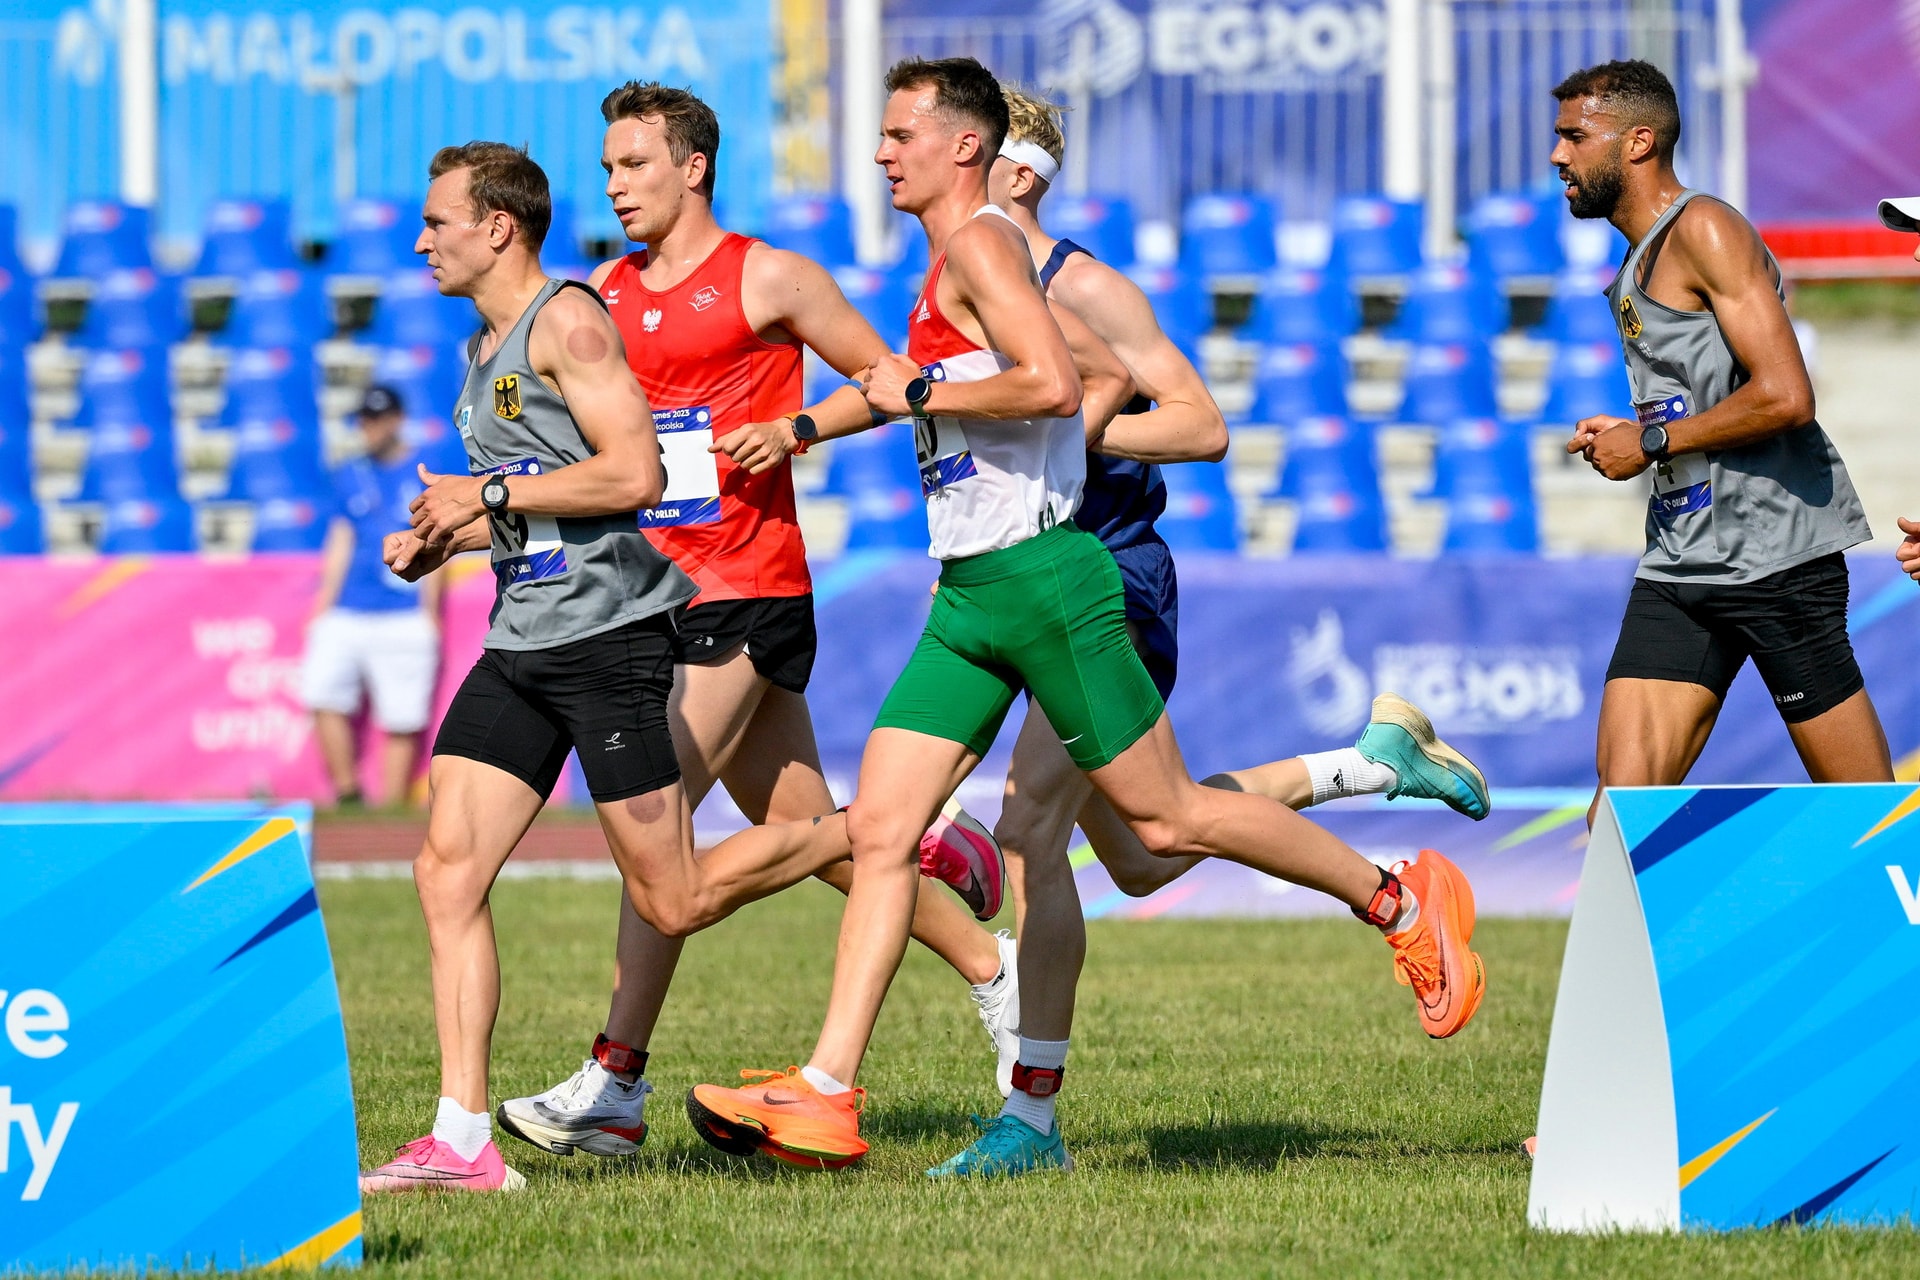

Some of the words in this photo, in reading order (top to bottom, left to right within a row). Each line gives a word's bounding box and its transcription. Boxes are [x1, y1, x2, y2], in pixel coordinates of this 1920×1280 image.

[164, 8, 706, 85] MAŁOPOLSKA
[1654, 402, 1668, 413] 2023
[652, 412, 671, 420] ames
[673, 409, 690, 418] 2023
[503, 463, 522, 475] 2023
[655, 509, 680, 519] ORLEN
[1783, 691, 1804, 703] JAKO
[0, 988, 70, 1059] e
